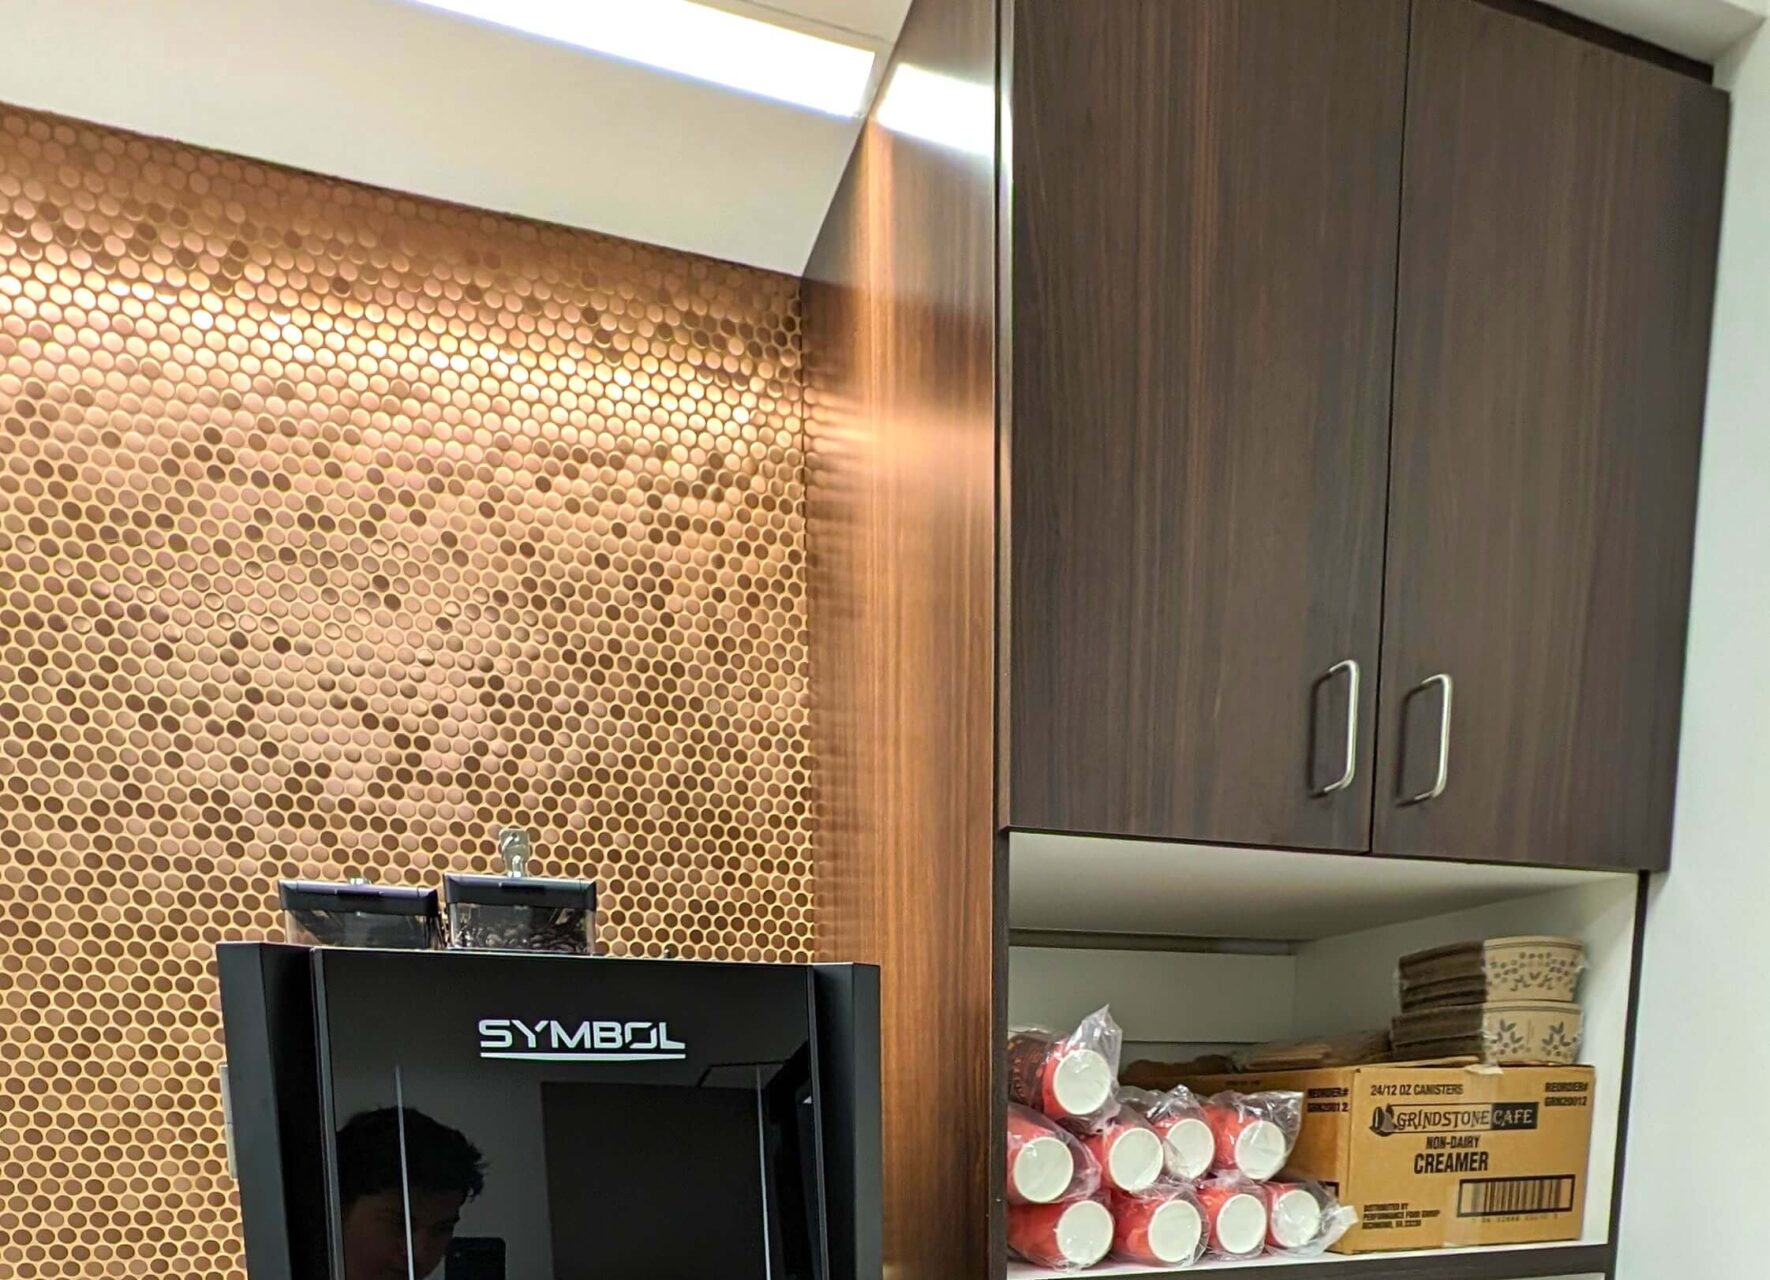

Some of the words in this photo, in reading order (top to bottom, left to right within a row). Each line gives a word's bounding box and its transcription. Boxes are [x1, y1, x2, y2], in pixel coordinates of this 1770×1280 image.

[478, 1019, 686, 1050] SYMBOL
[1370, 1084, 1397, 1096] 24/12
[1399, 1084, 1412, 1095] OZ
[1413, 1083, 1464, 1096] CANISTERS
[1397, 1109, 1491, 1130] GRINDSTONE
[1493, 1109, 1533, 1127] CAFE
[1426, 1135, 1480, 1150] NON-DAIRY
[1414, 1151, 1489, 1174] CREAMER
